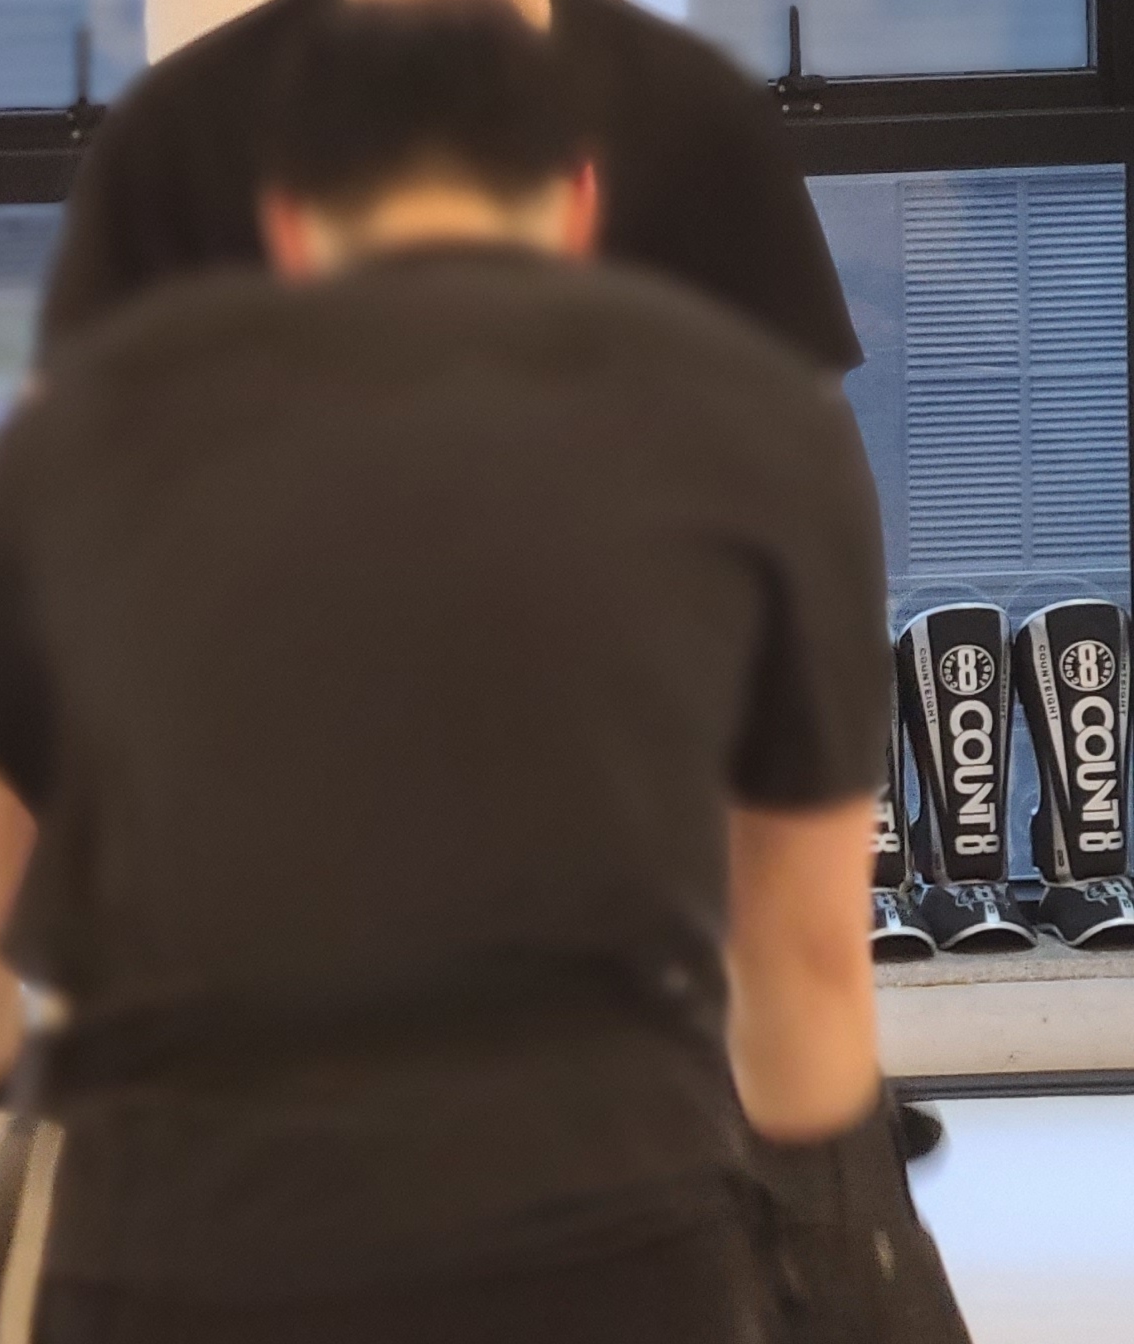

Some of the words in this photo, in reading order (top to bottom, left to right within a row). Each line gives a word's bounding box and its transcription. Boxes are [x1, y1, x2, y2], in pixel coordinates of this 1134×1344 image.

[918, 647, 937, 725] COUNTEIGHT
[957, 648, 977, 691] 8
[1039, 644, 1059, 720] COUNTEIGHT
[1078, 643, 1099, 687] 8
